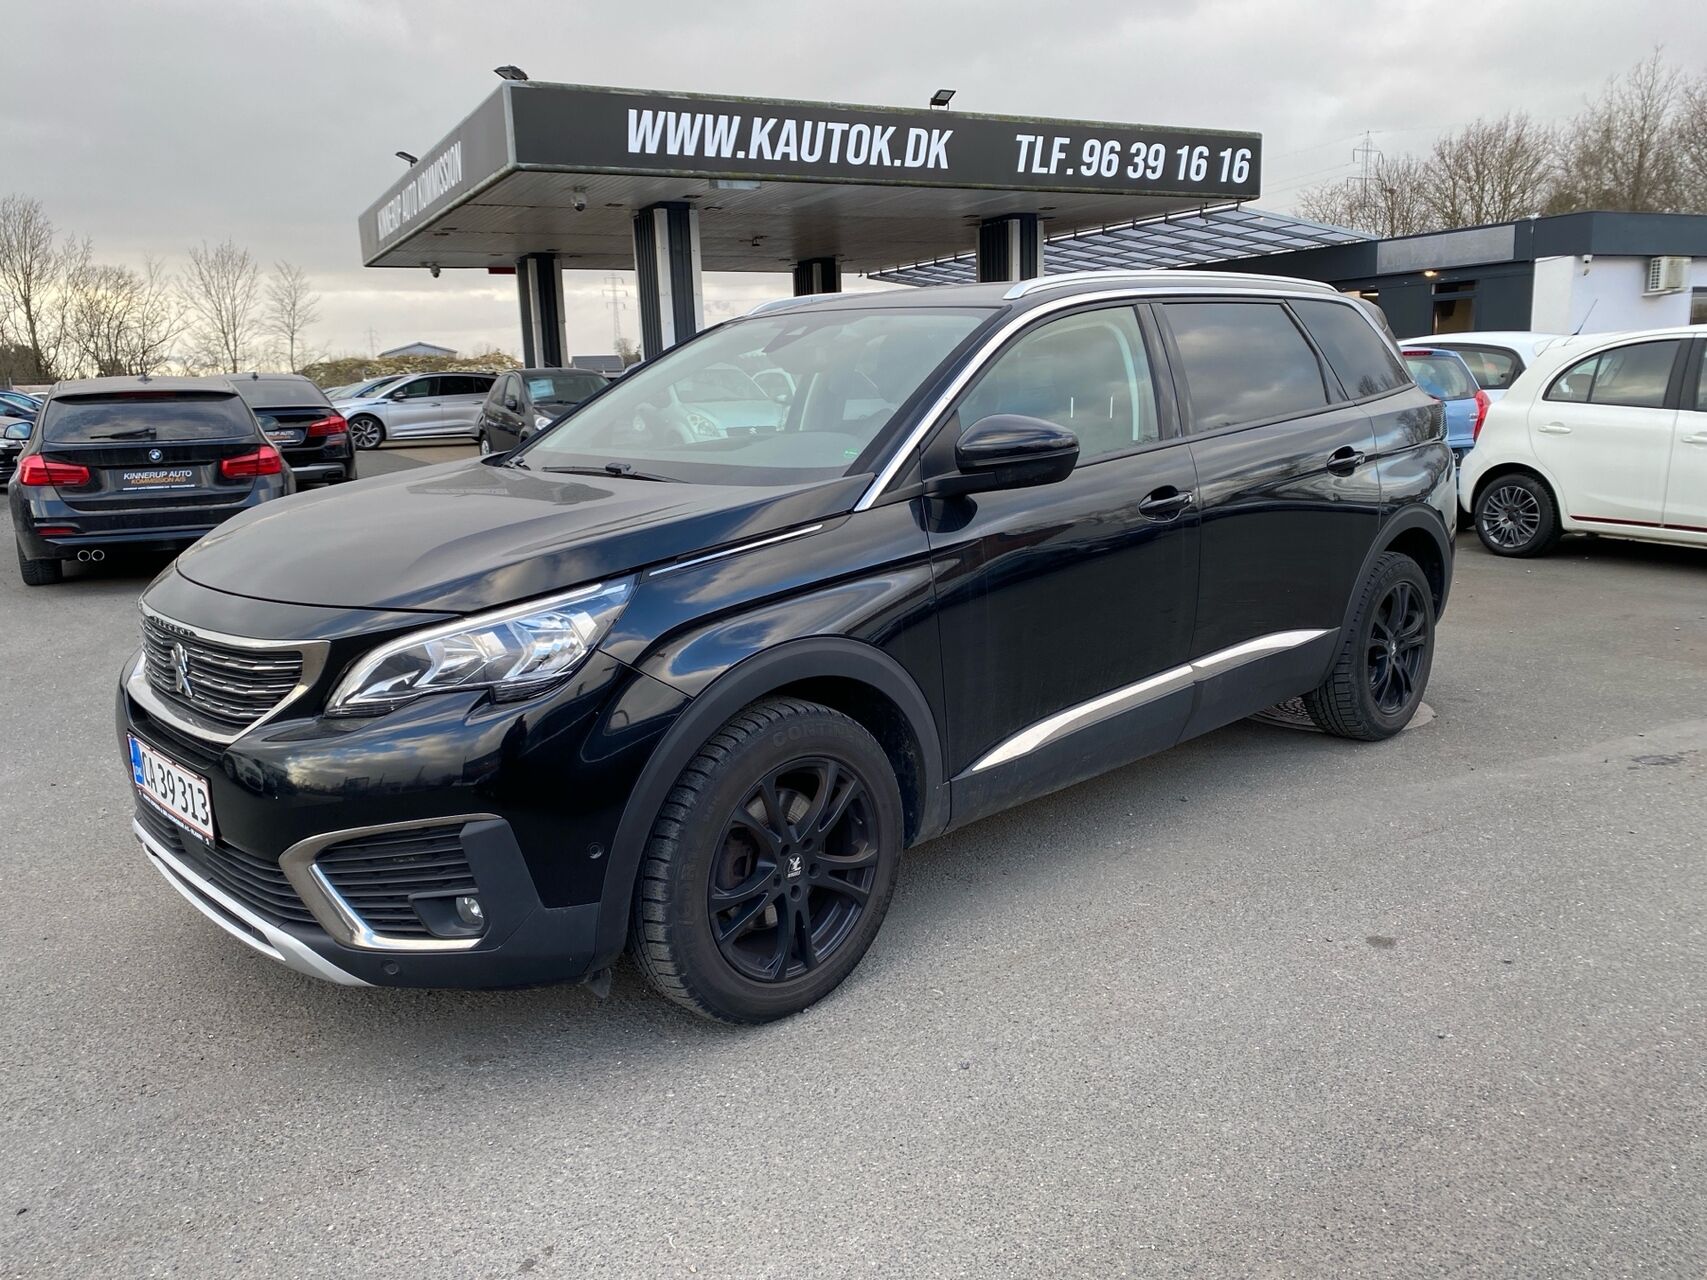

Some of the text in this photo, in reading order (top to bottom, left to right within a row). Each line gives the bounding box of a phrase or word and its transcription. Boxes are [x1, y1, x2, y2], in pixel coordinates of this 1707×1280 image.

[627, 108, 954, 170] WWW.KAUTOK.DK
[1015, 134, 1251, 184] TLF. 96 39 16 16
[124, 469, 193, 480] KINNERUP AUTO
[158, 763, 176, 806] 39
[178, 776, 210, 827] 313
